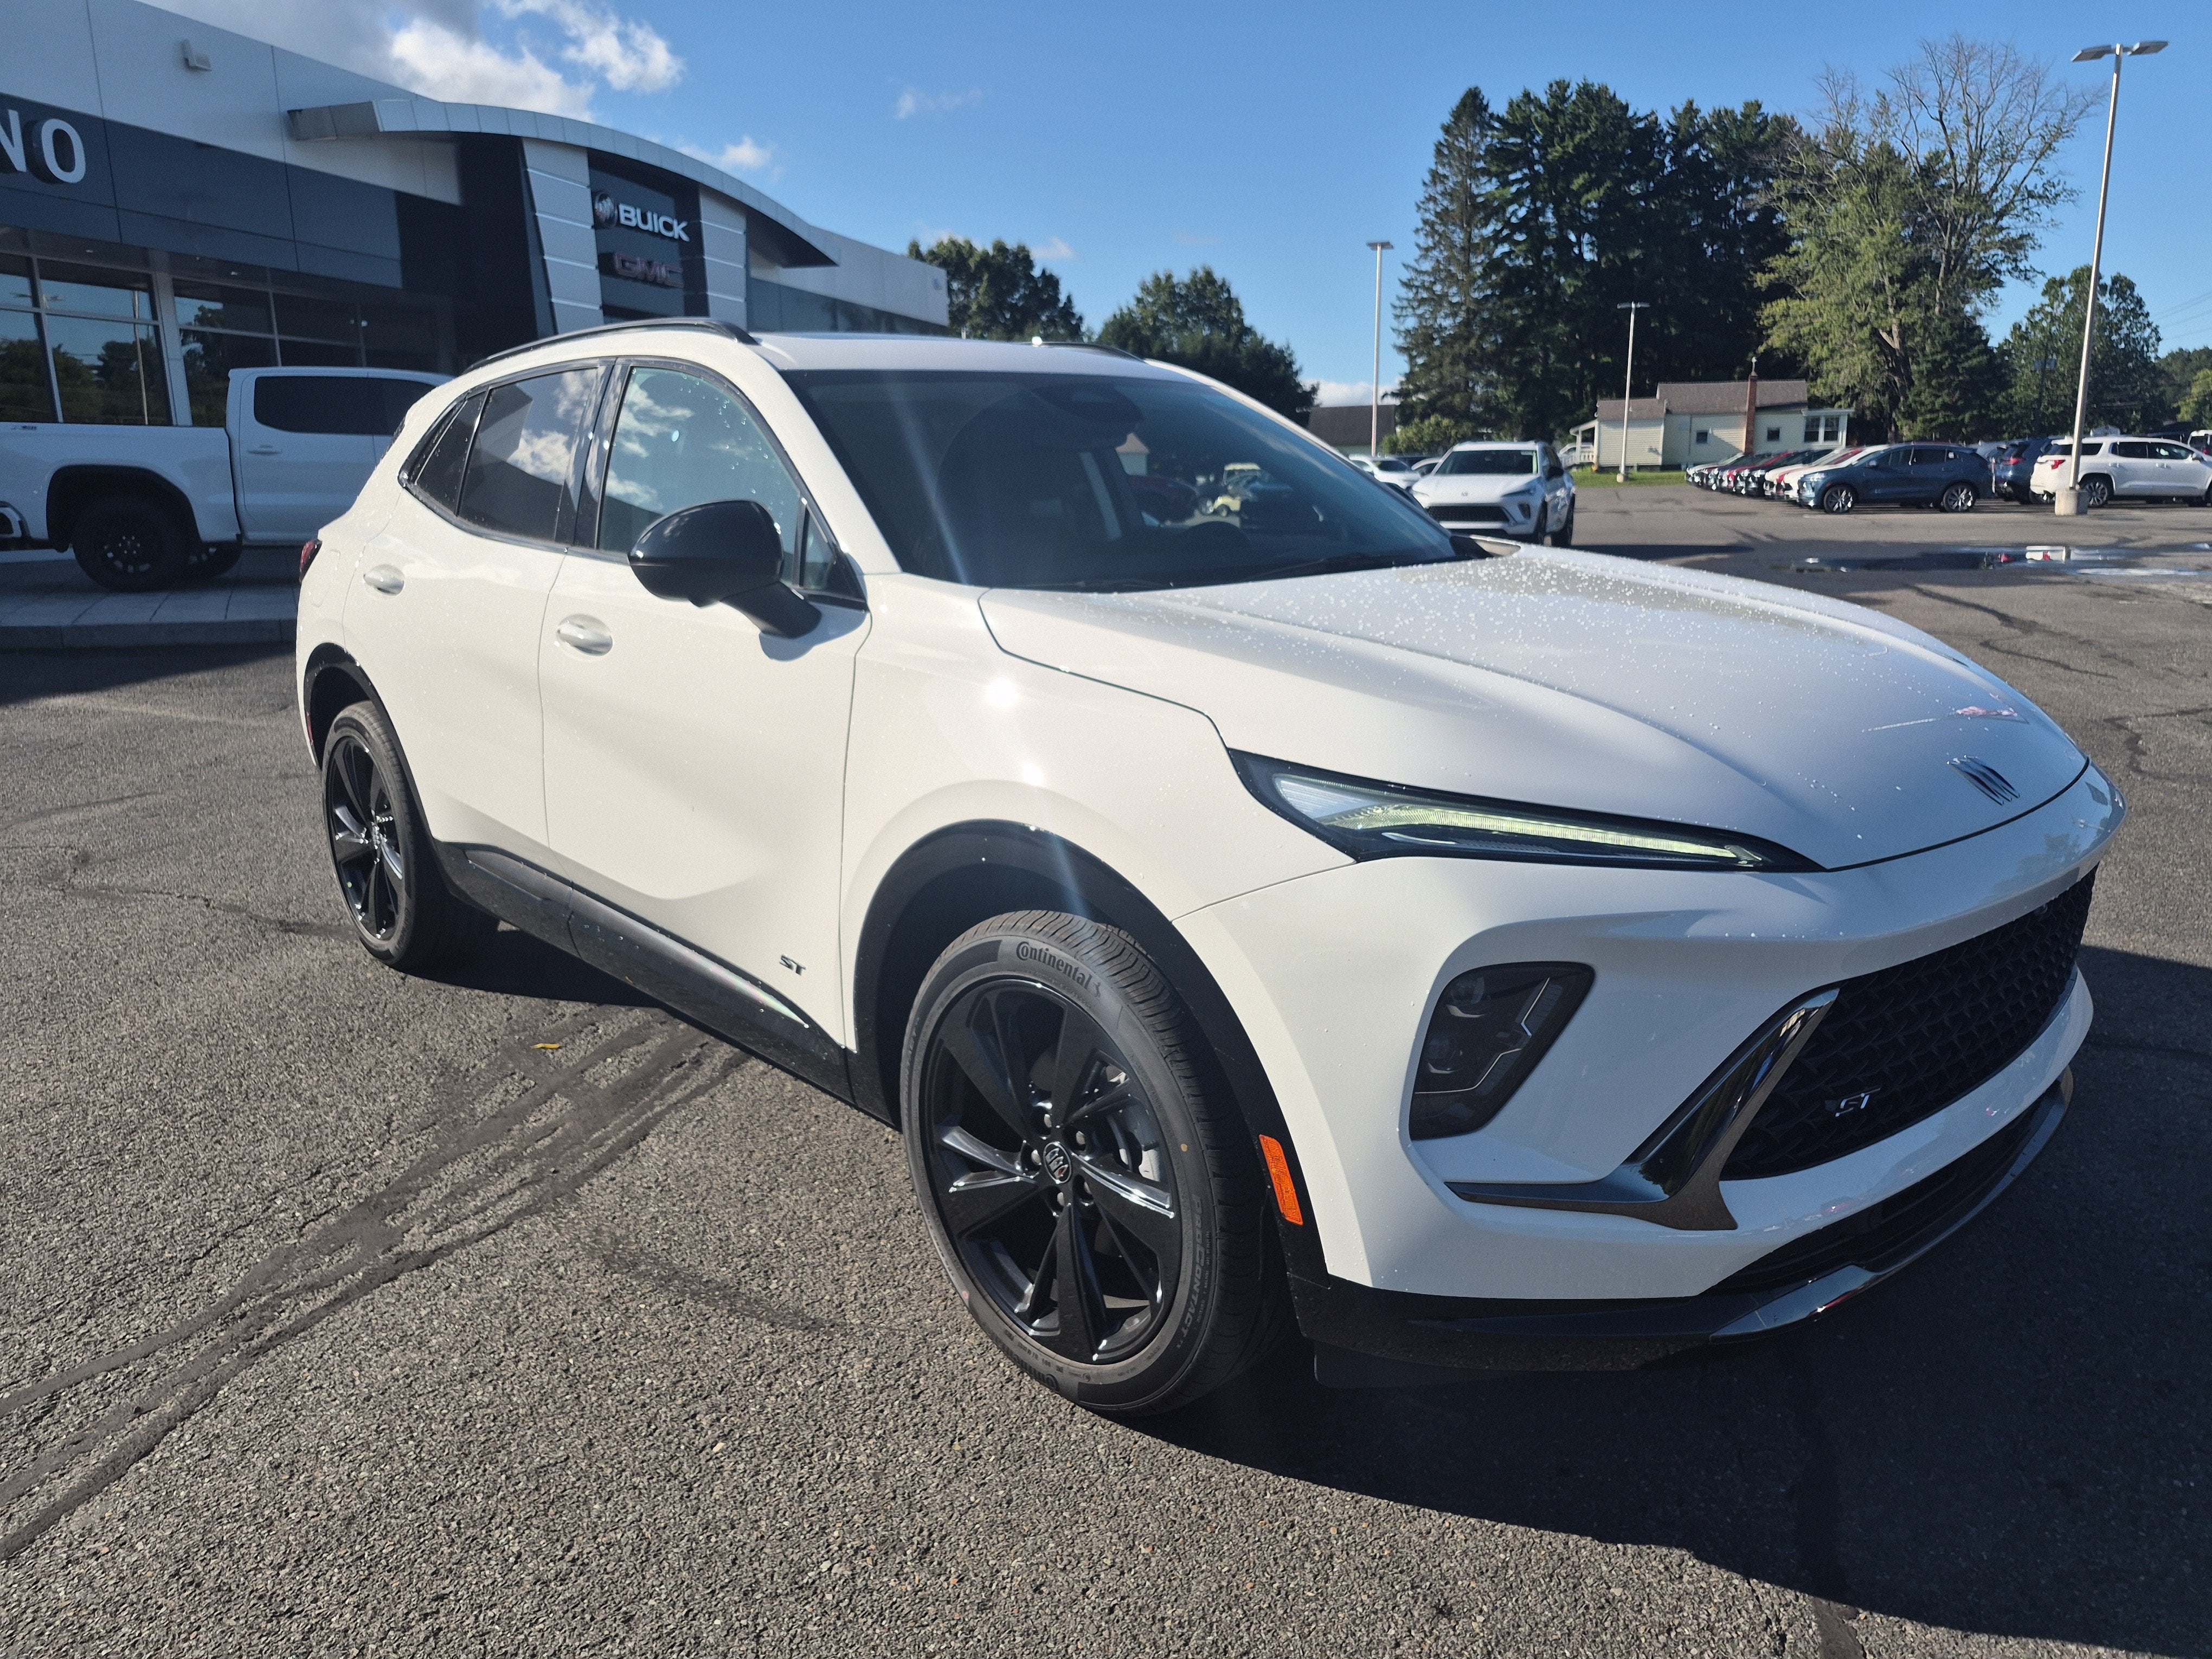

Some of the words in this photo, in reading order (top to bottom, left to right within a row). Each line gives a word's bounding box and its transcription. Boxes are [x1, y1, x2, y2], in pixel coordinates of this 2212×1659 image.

[618, 203, 690, 242] BUICK
[614, 252, 684, 289] GMC
[779, 954, 807, 976] ST
[1015, 941, 1093, 990] Continental
[1835, 1087, 1881, 1117] ST
